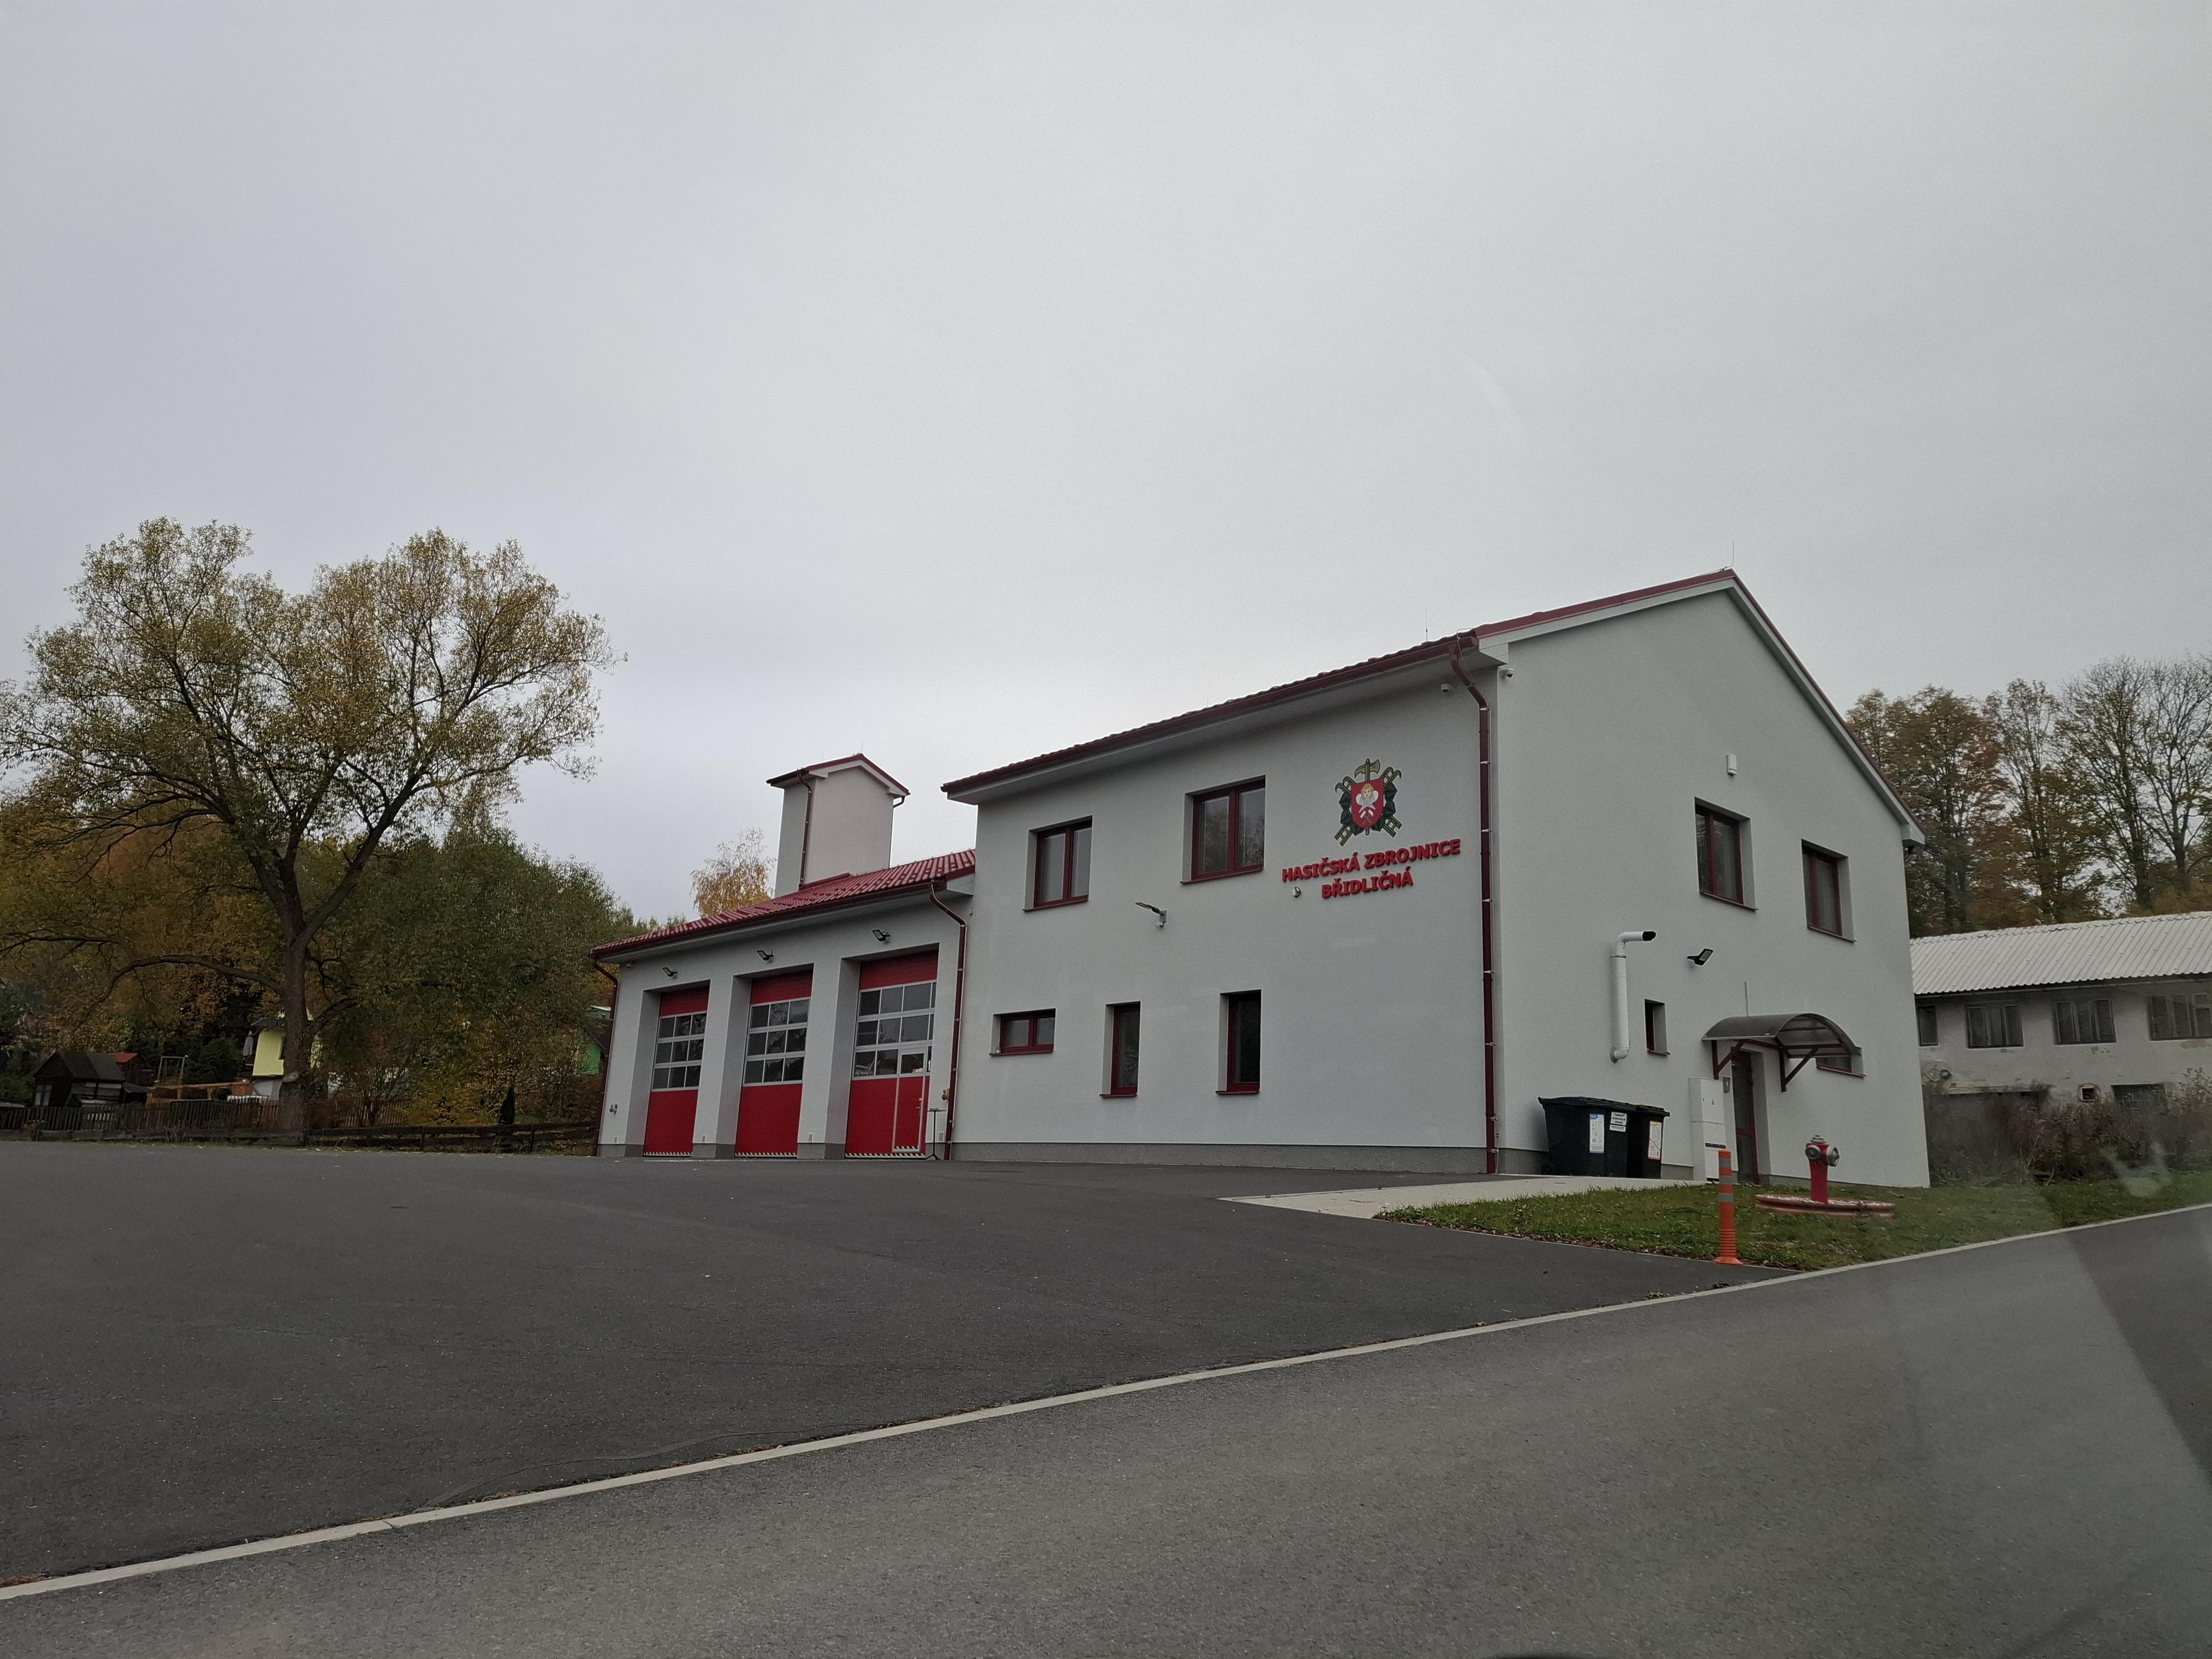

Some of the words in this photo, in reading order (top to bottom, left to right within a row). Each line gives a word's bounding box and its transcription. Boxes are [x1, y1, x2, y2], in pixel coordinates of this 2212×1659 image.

[1282, 852, 1360, 883] HASIČSKÁ
[1364, 839, 1460, 869] ZBROJNICE
[1322, 866, 1413, 899] BŘIDLIČNÁ
